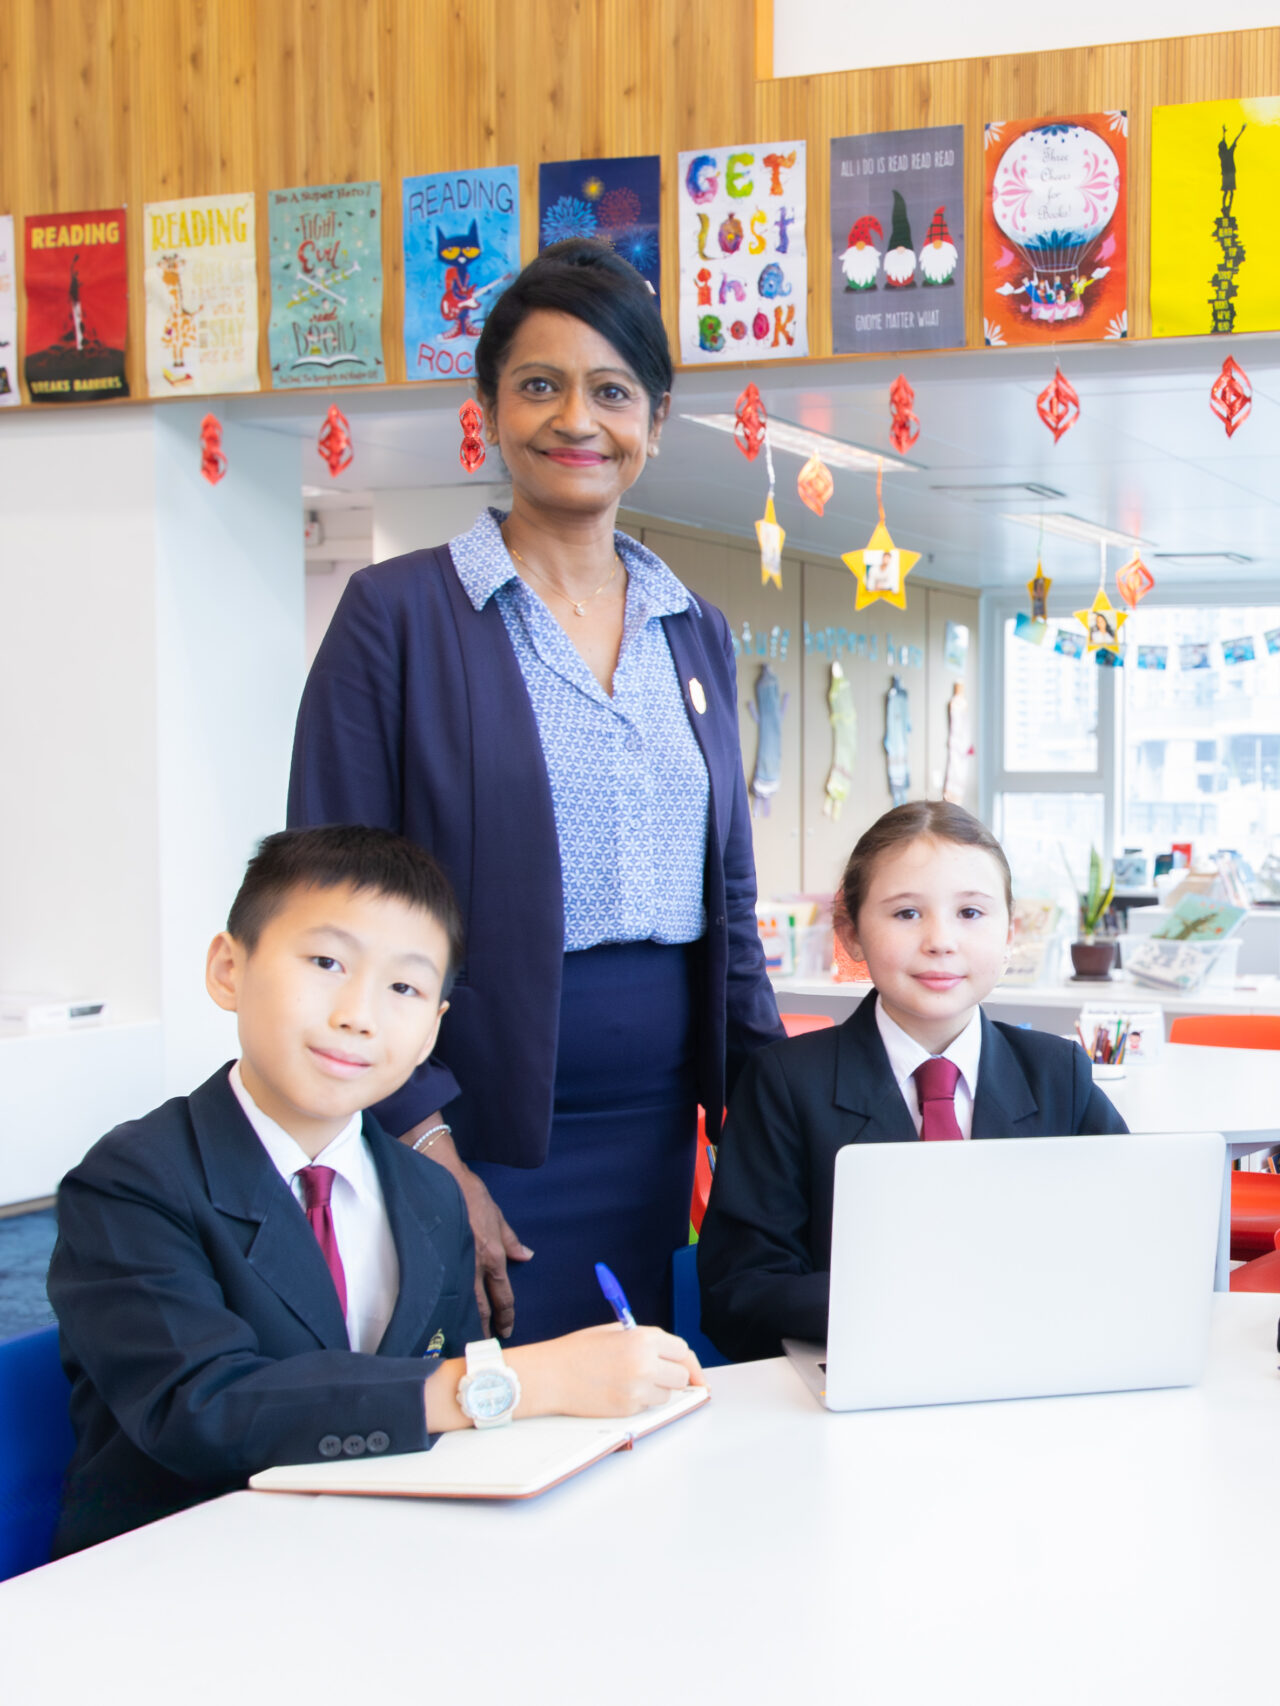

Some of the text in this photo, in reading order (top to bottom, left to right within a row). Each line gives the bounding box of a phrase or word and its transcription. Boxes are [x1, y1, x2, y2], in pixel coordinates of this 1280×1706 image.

[686, 150, 797, 205] GET
[841, 158, 855, 177] ALL
[862, 157, 875, 176] DO
[877, 156, 886, 174] IS
[888, 153, 909, 173] READ
[911, 151, 932, 171] READ
[934, 148, 955, 168] READ
[409, 178, 514, 224] READING
[31, 222, 119, 249] READING
[152, 205, 247, 251] READING
[299, 210, 337, 241] FIGHT
[698, 304, 796, 353] BOOK
[885, 311, 915, 329] MATTER
[417, 343, 480, 375] ROC
